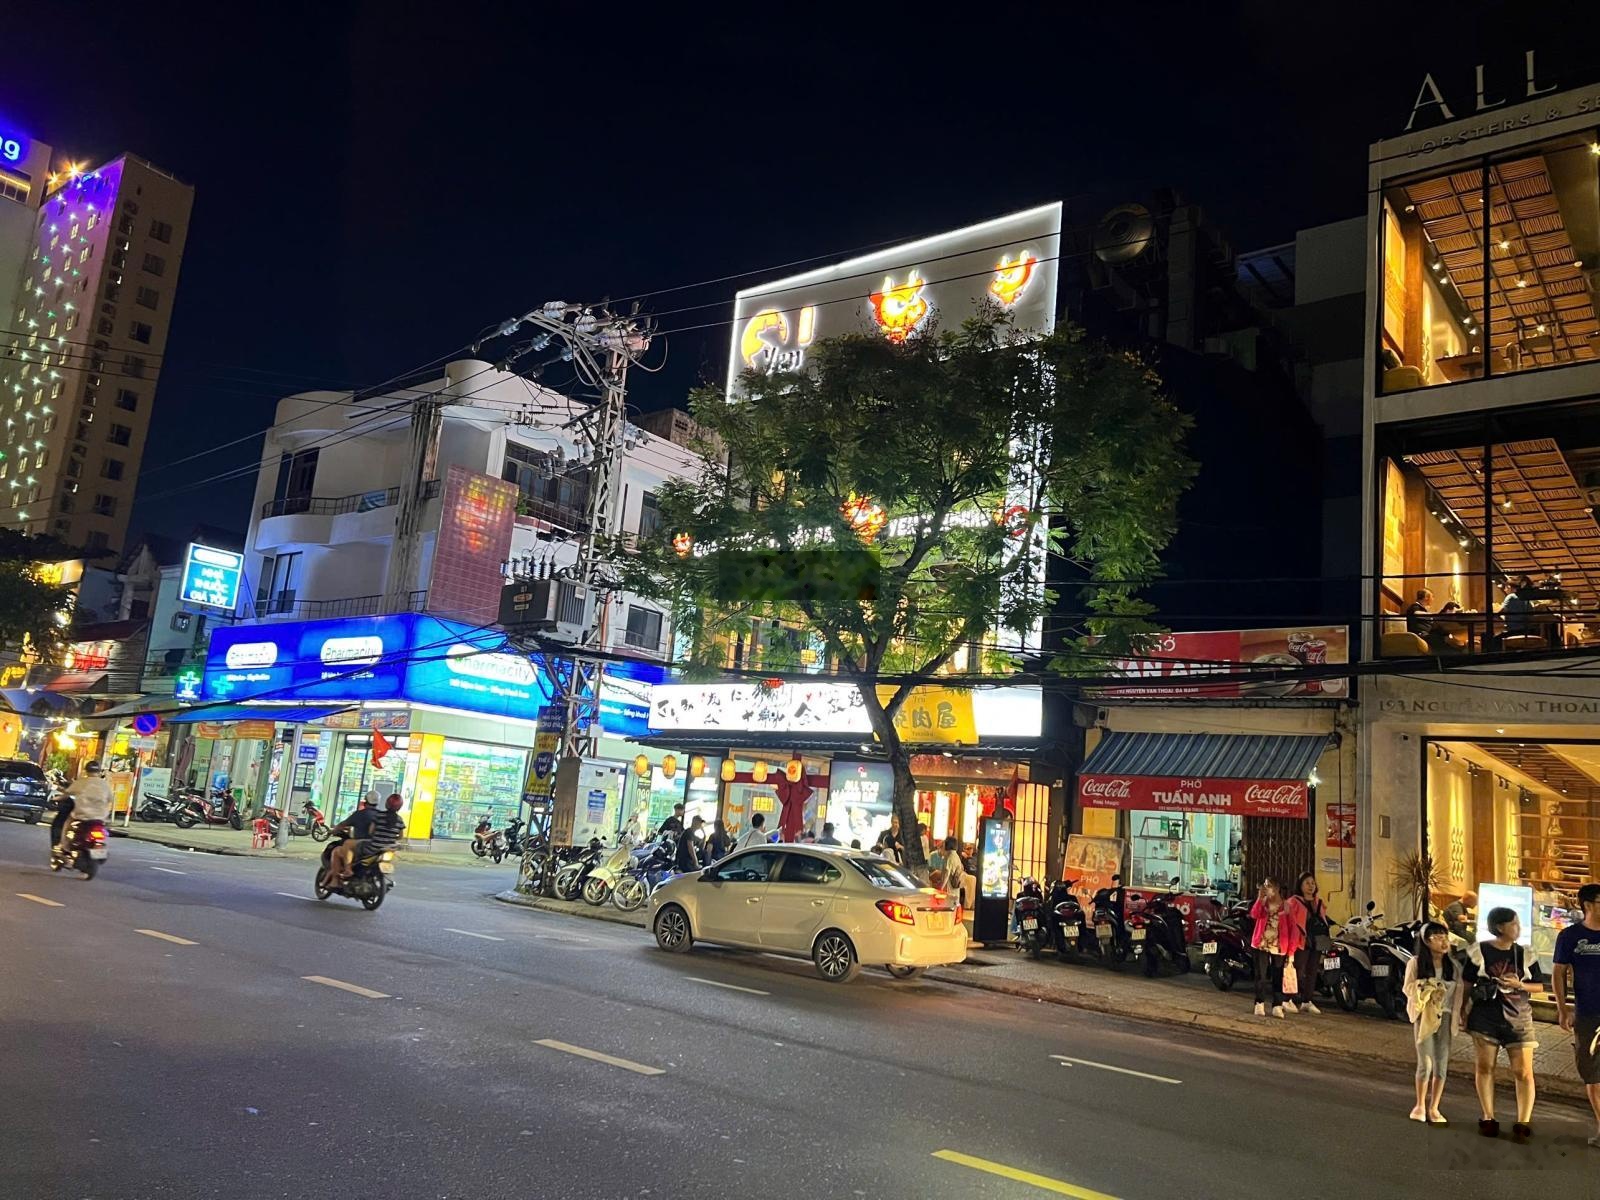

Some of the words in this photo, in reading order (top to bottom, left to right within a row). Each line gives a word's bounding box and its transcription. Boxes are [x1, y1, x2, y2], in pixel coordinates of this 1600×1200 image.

[1403, 50, 1558, 132] ALL
[1407, 114, 1532, 159] LOBSTERS
[1082, 779, 1133, 798] Coca-Cola
[1152, 789, 1194, 804] TUẤN
[1197, 793, 1232, 806] ANH
[1244, 784, 1304, 805] Coca-Cola
